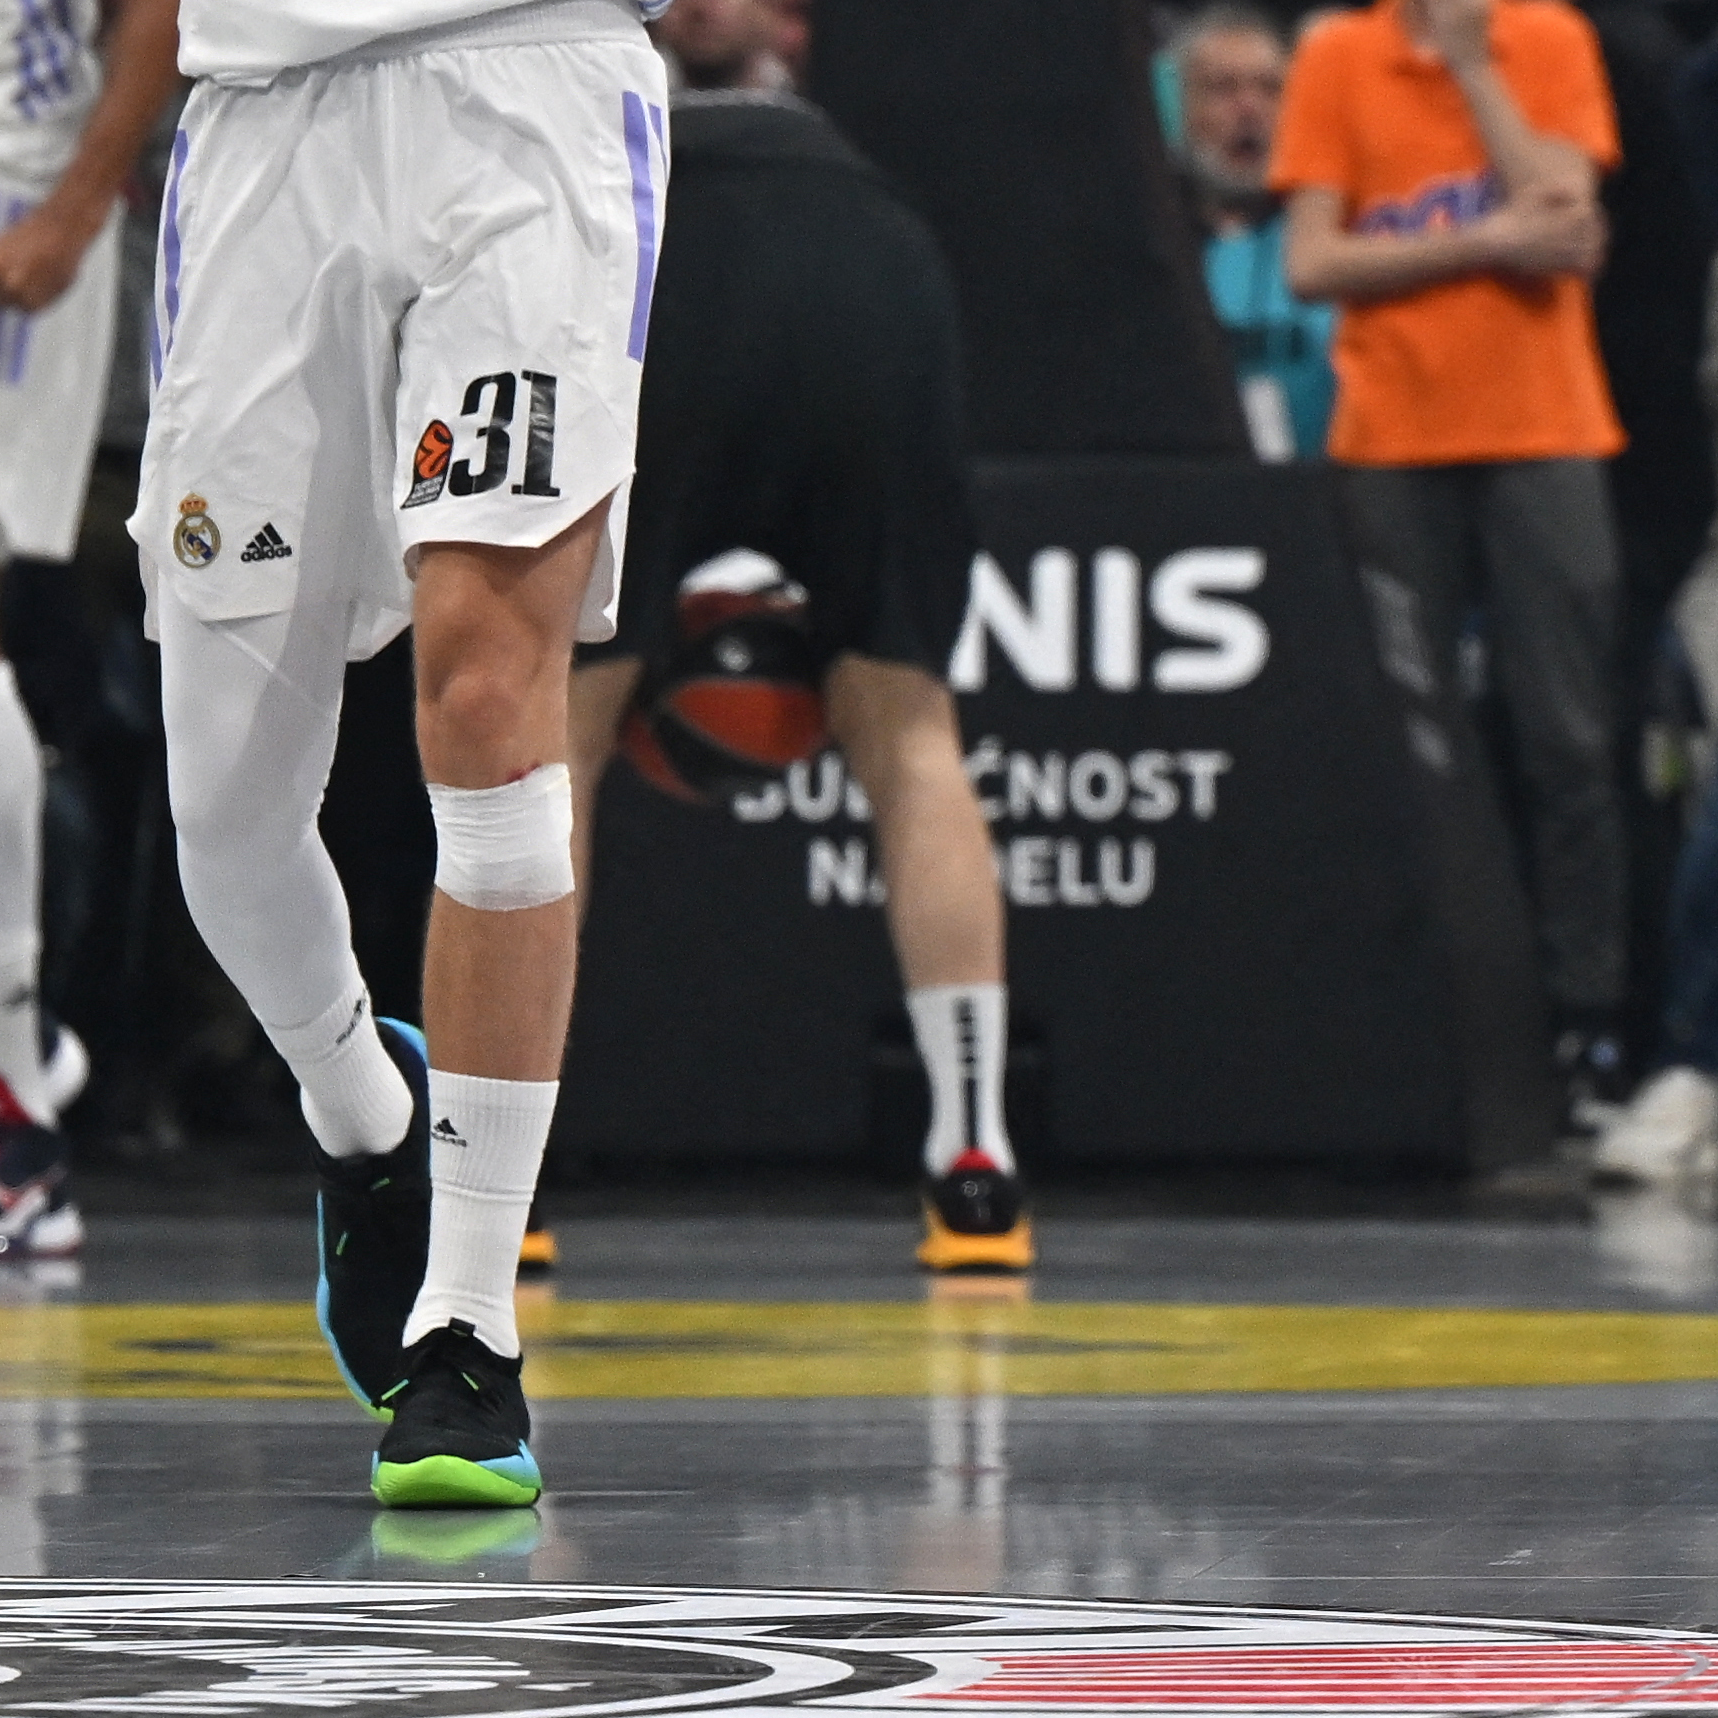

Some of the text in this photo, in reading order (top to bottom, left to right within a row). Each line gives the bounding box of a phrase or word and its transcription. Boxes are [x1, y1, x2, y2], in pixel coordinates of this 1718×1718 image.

[447, 369, 561, 498] 31
[240, 543, 293, 563] adidas
[948, 545, 1271, 693] NIS
[807, 835, 1158, 908] N ELU
